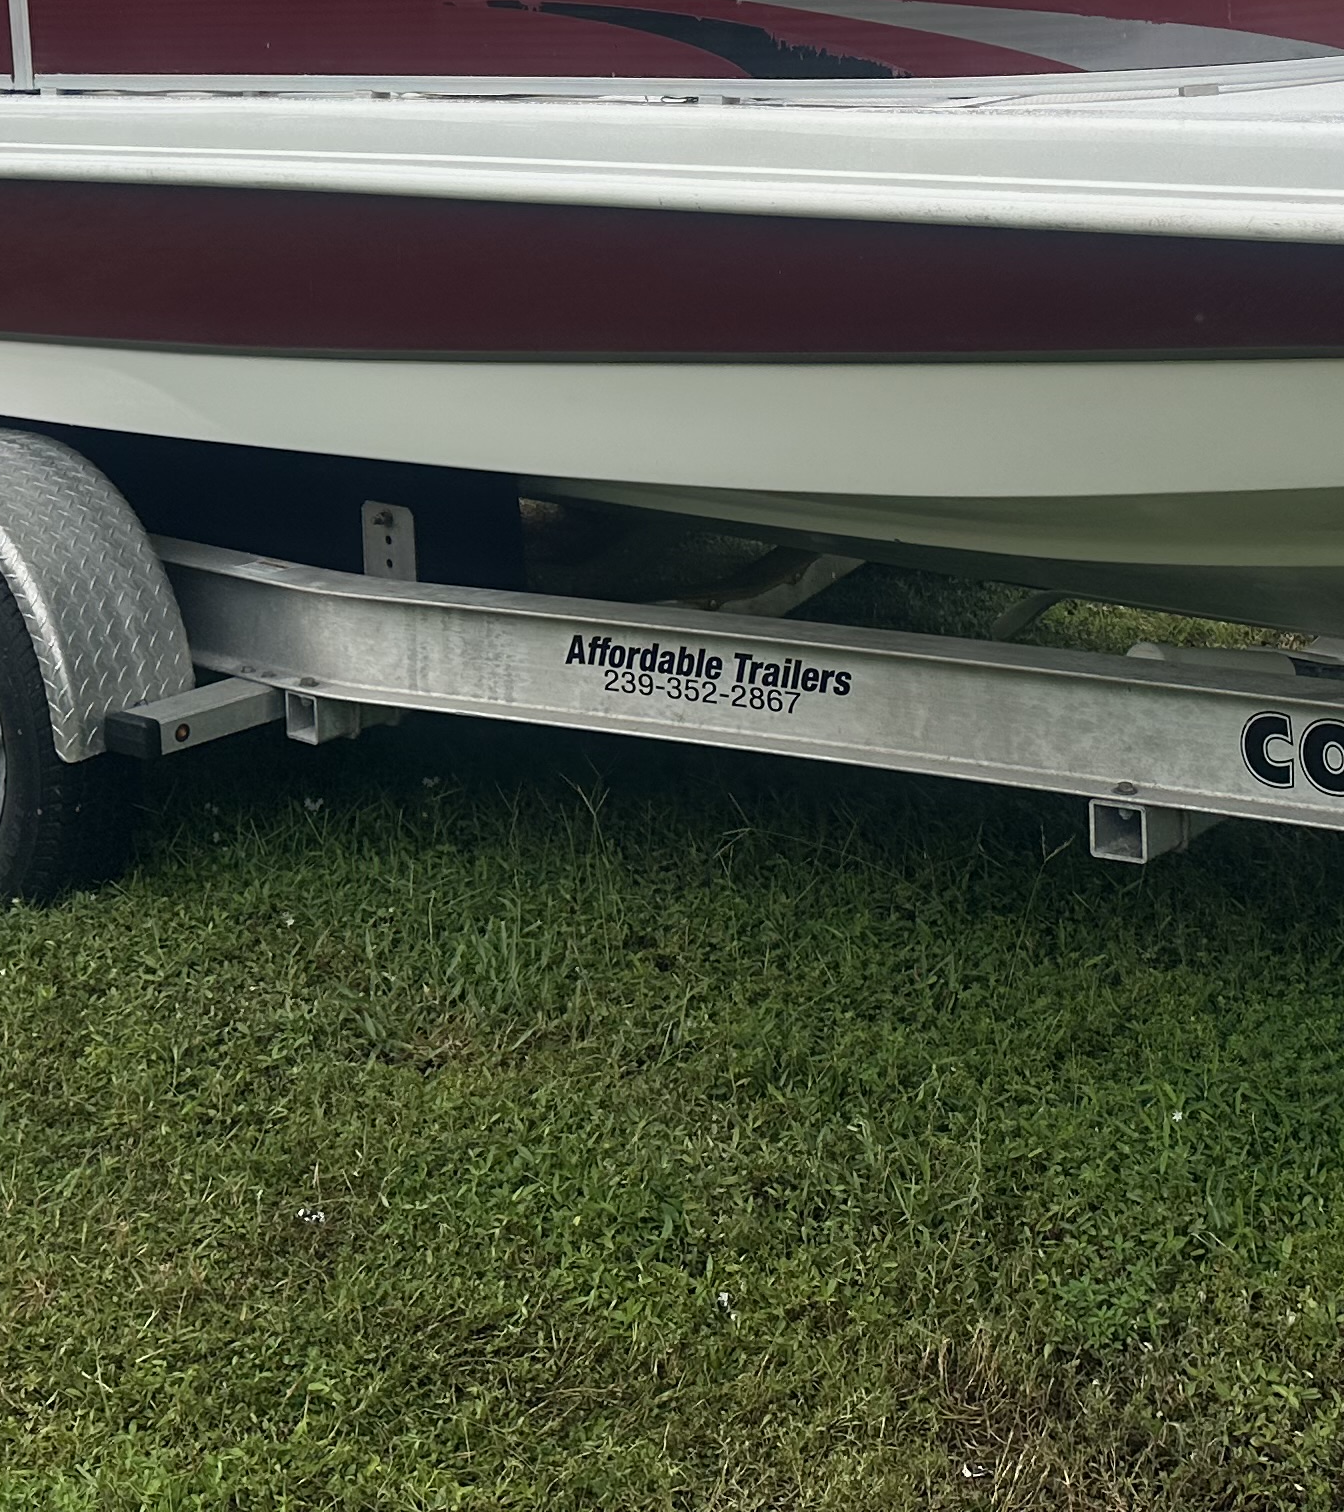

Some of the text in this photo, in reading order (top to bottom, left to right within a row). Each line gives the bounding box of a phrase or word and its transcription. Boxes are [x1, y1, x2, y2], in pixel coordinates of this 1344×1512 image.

[565, 634, 853, 696] Affordable Trailers
[604, 669, 801, 715] 239-352-2867
